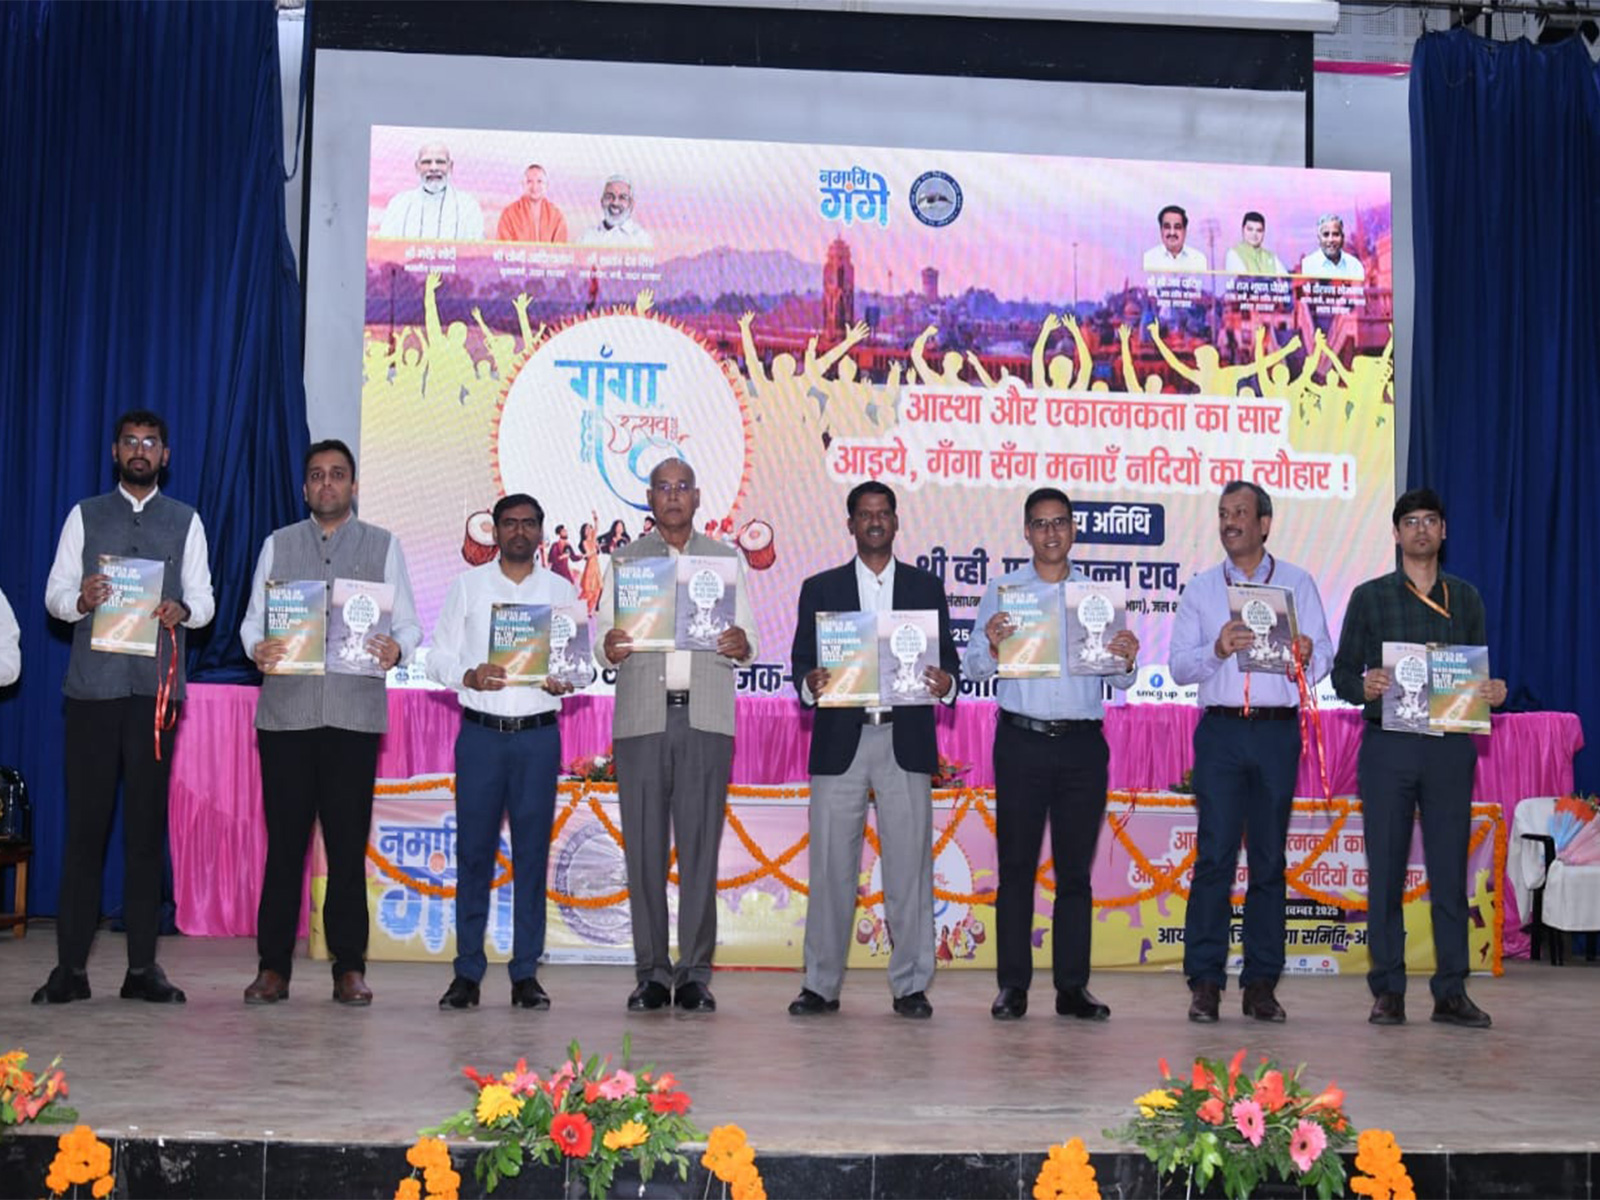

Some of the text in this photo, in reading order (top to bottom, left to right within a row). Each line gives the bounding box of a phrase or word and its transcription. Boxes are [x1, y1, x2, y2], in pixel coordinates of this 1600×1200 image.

[820, 166, 870, 189] नमामि
[820, 173, 890, 226] गंगे
[554, 344, 667, 406] गंगा
[907, 385, 1282, 434] आस्था और एकात्मकता का सार
[834, 437, 1349, 490] आइये, गँगा सँग मनाएँ नदियों का त्यौहार !
[1093, 506, 1151, 535] अतिथि
[1136, 563, 1185, 596] राव,
[951, 628, 970, 642] 25
[1303, 861, 1348, 888] नदियों
